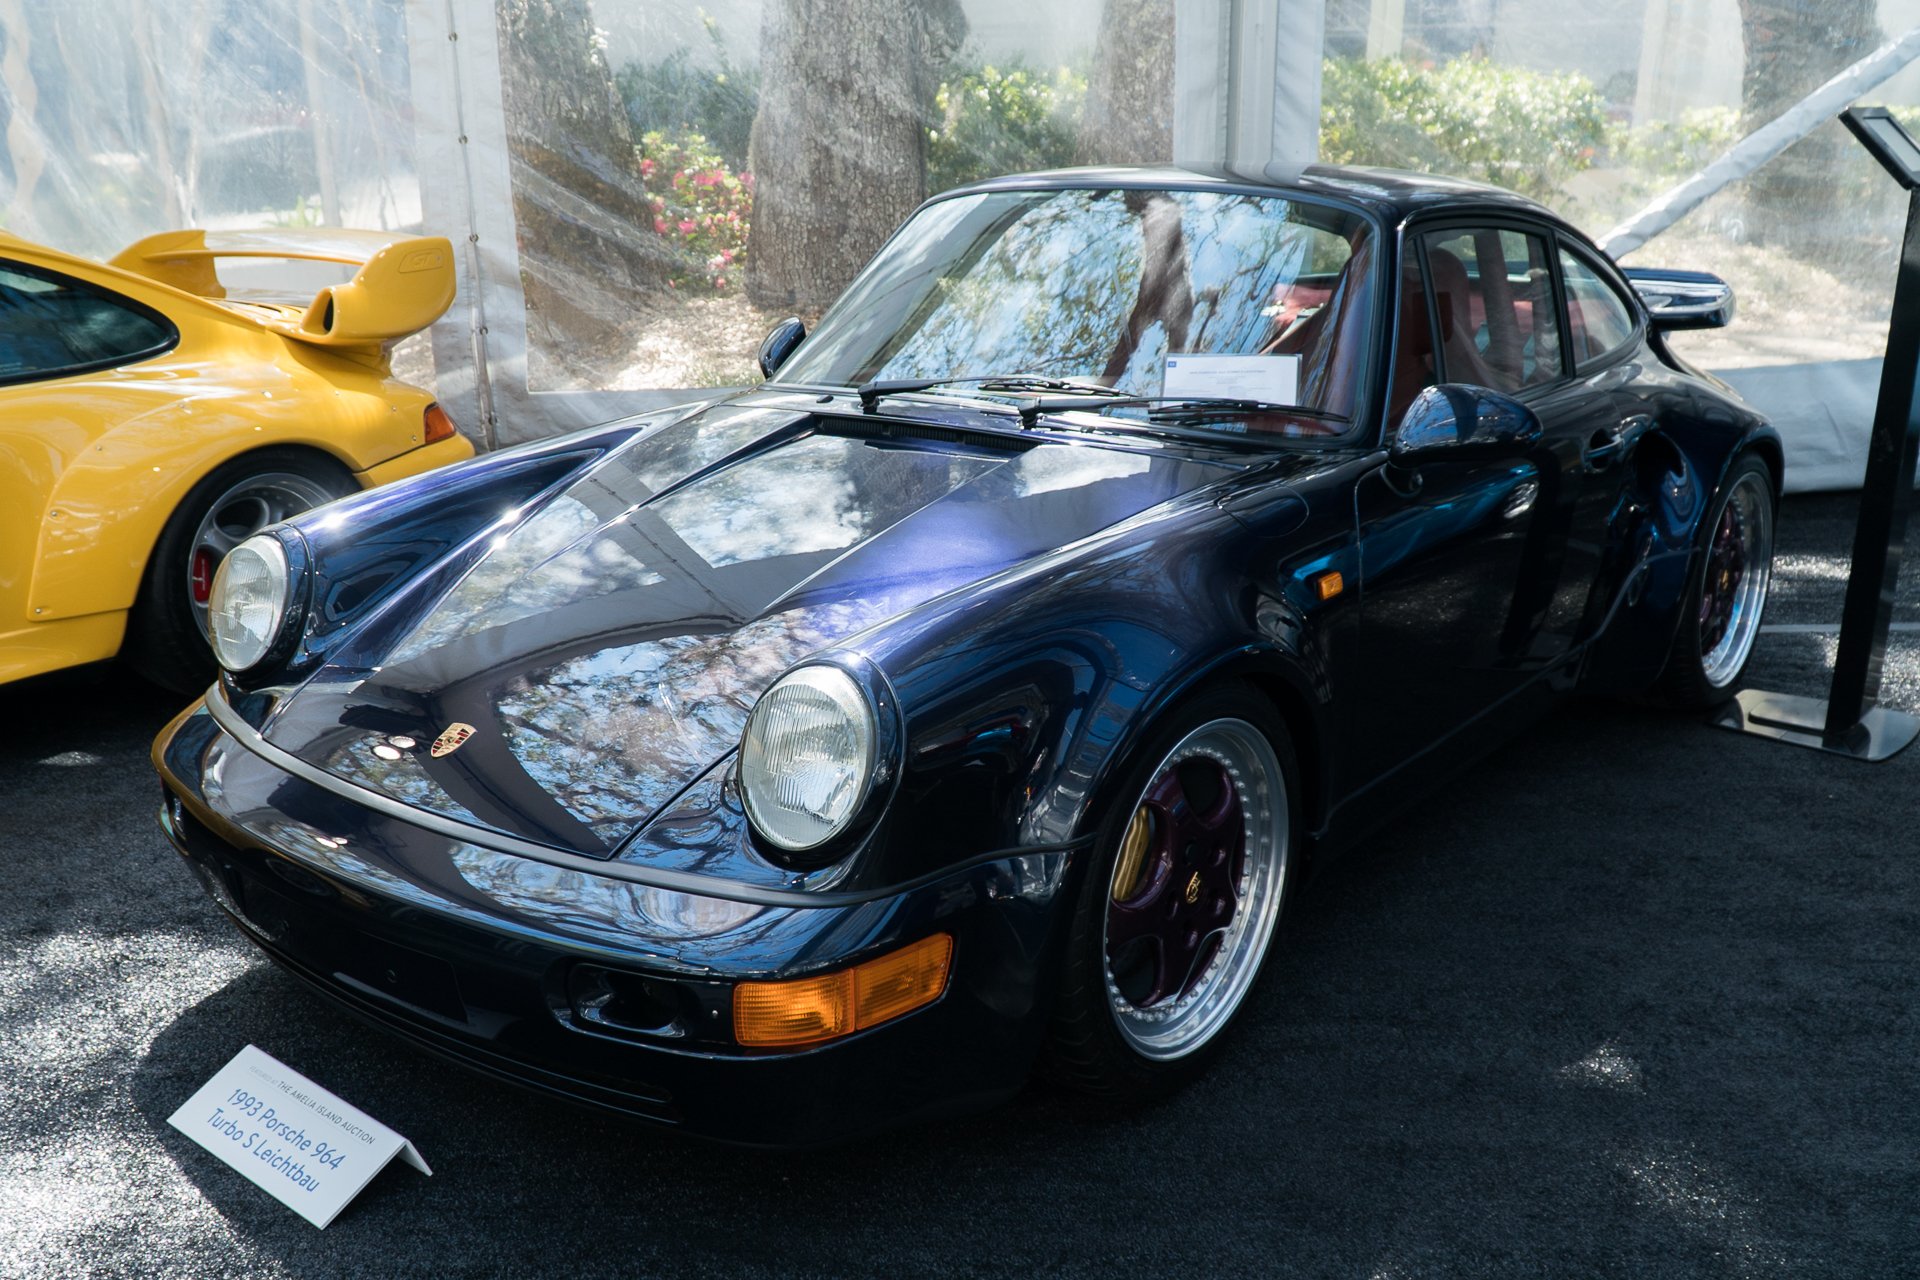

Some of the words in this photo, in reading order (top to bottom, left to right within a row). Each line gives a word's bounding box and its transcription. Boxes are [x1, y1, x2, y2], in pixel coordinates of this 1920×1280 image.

[207, 1107, 244, 1141] Turbo
[242, 1132, 260, 1148] S
[253, 1139, 320, 1192] Leichtbau
[227, 1088, 264, 1117] 1993
[257, 1108, 312, 1151] Porsche
[310, 1142, 346, 1170] 964
[277, 1080, 291, 1094] THE
[290, 1089, 317, 1109] AMELIA
[315, 1105, 343, 1125] ISLAND
[340, 1121, 376, 1145] AUCTION
